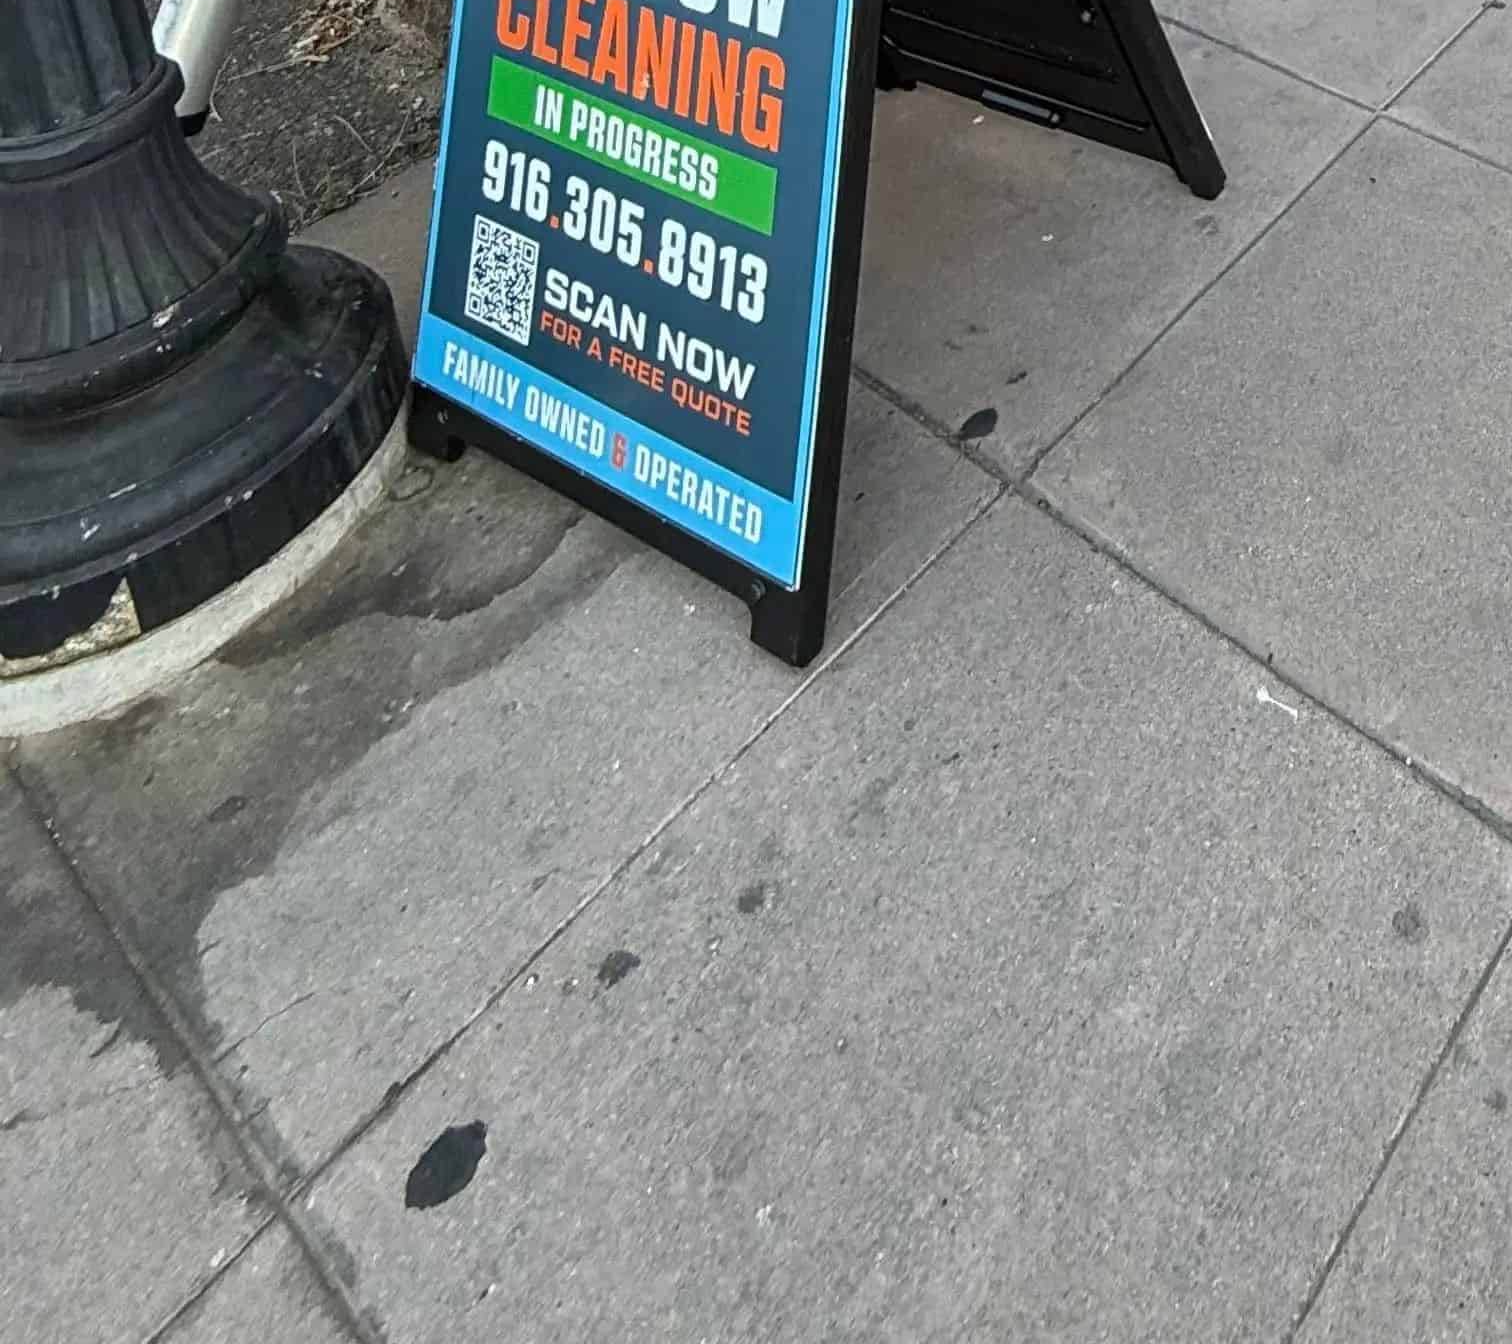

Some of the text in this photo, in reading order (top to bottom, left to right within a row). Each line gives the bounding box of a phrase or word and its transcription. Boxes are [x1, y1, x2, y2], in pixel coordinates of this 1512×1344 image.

[535, 85, 719, 200] IN PROGRESS
[482, 140, 768, 323] 916.305.8913
[539, 310, 752, 436] FOR A FREE QUOTE
[543, 268, 755, 400] SCAN NOW
[442, 343, 519, 409] FAMILY
[523, 391, 605, 459] OWNED
[633, 445, 763, 545] OPERATED
